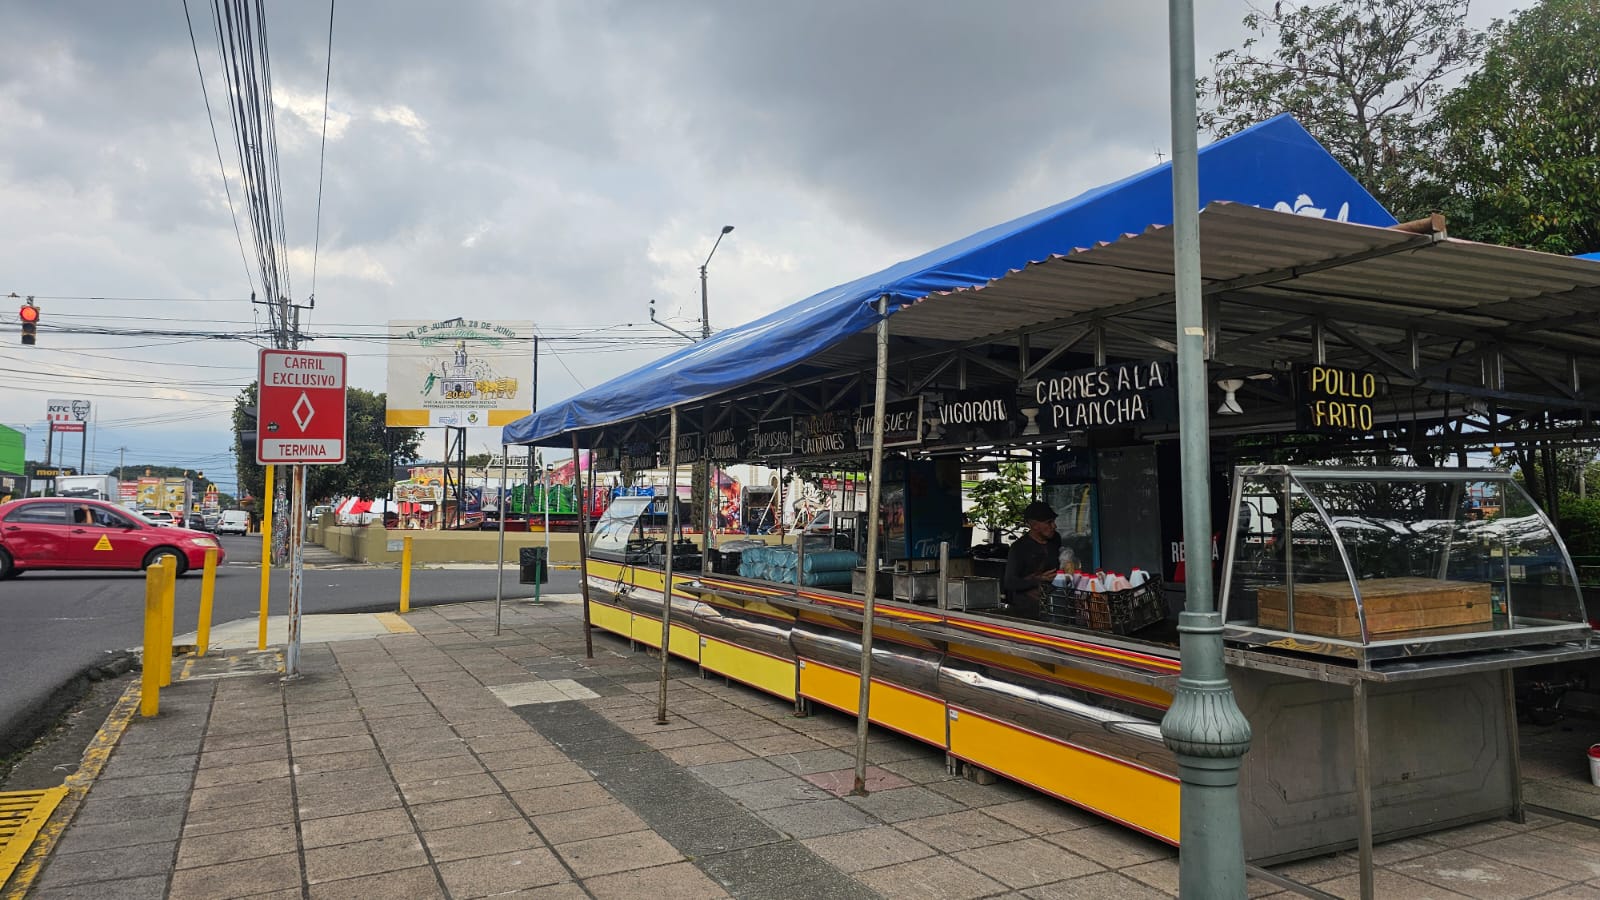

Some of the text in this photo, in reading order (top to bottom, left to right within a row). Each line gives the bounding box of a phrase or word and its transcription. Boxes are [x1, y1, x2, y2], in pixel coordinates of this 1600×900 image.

[417, 325, 428, 335] DE
[430, 320, 453, 331] JUNIO
[455, 320, 466, 328] AL
[480, 321, 492, 330] DE
[493, 325, 516, 338] JUNIO
[284, 357, 325, 370] CARRIL
[273, 372, 335, 386] EXCLUSIVO
[1036, 361, 1164, 404] CARNES A LA
[1312, 366, 1375, 398] POLLO
[1053, 394, 1146, 428] PLANCHA
[1315, 400, 1373, 431] FRITO
[279, 444, 327, 456] TERMINA
